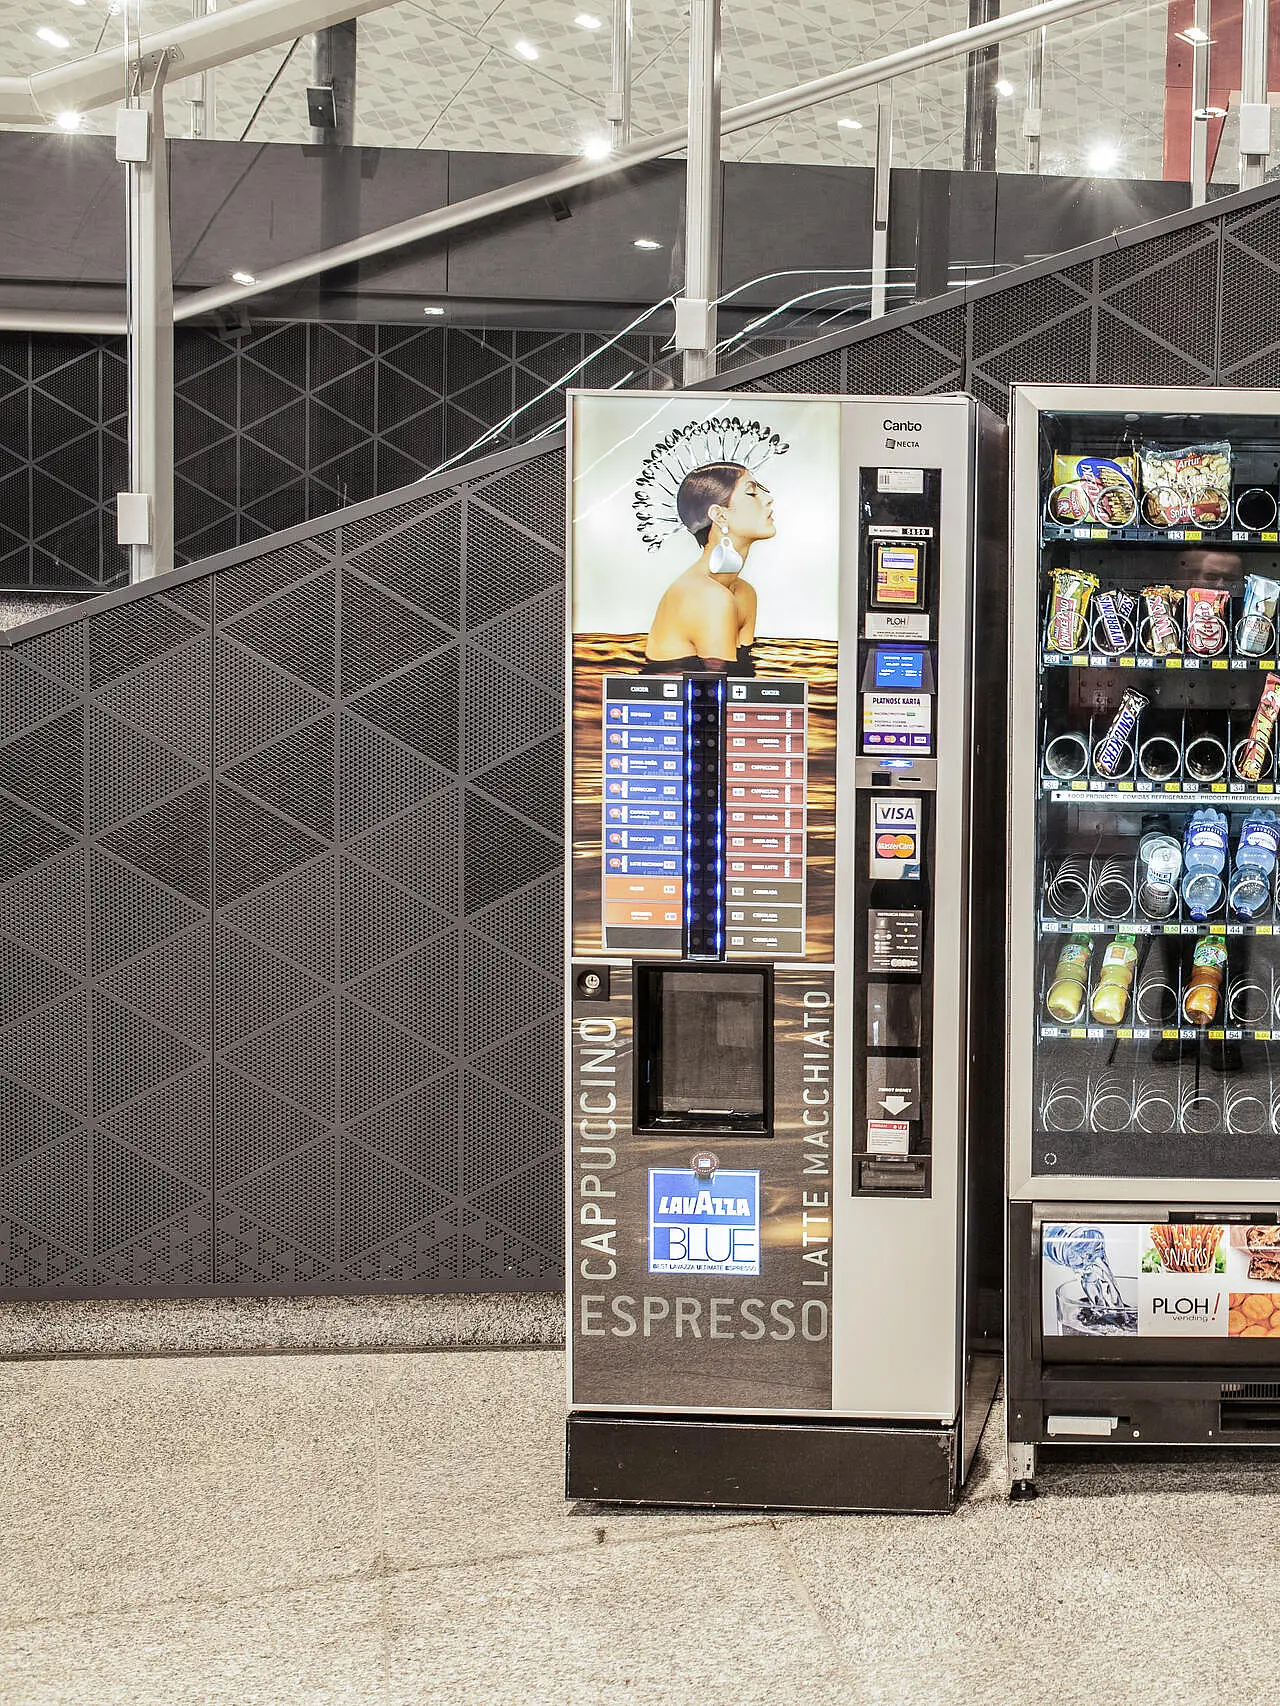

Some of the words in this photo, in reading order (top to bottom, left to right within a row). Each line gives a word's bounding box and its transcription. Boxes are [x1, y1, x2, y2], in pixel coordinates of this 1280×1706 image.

[883, 419, 922, 432] Canto
[896, 441, 920, 449] NECTA
[1177, 457, 1201, 471] Artur
[1101, 711, 1134, 770] SNICKERS
[881, 807, 914, 820] VISA
[803, 990, 831, 1175] MACCHIATO
[580, 1018, 617, 1281] CAPPUCCINO
[658, 1190, 751, 1217] LAVAZZA
[668, 1226, 756, 1263] BLUE
[803, 1190, 829, 1287] LATTE
[669, 1263, 695, 1271] LAVAZZA
[696, 1263, 724, 1272] ULTIMATE
[725, 1264, 758, 1273] ESPRESSO
[1164, 1246, 1208, 1268] SNACKS
[581, 1295, 828, 1342] ESPRESSO
[1152, 1292, 1220, 1321] PLOH!
[1171, 1313, 1209, 1323] vending
